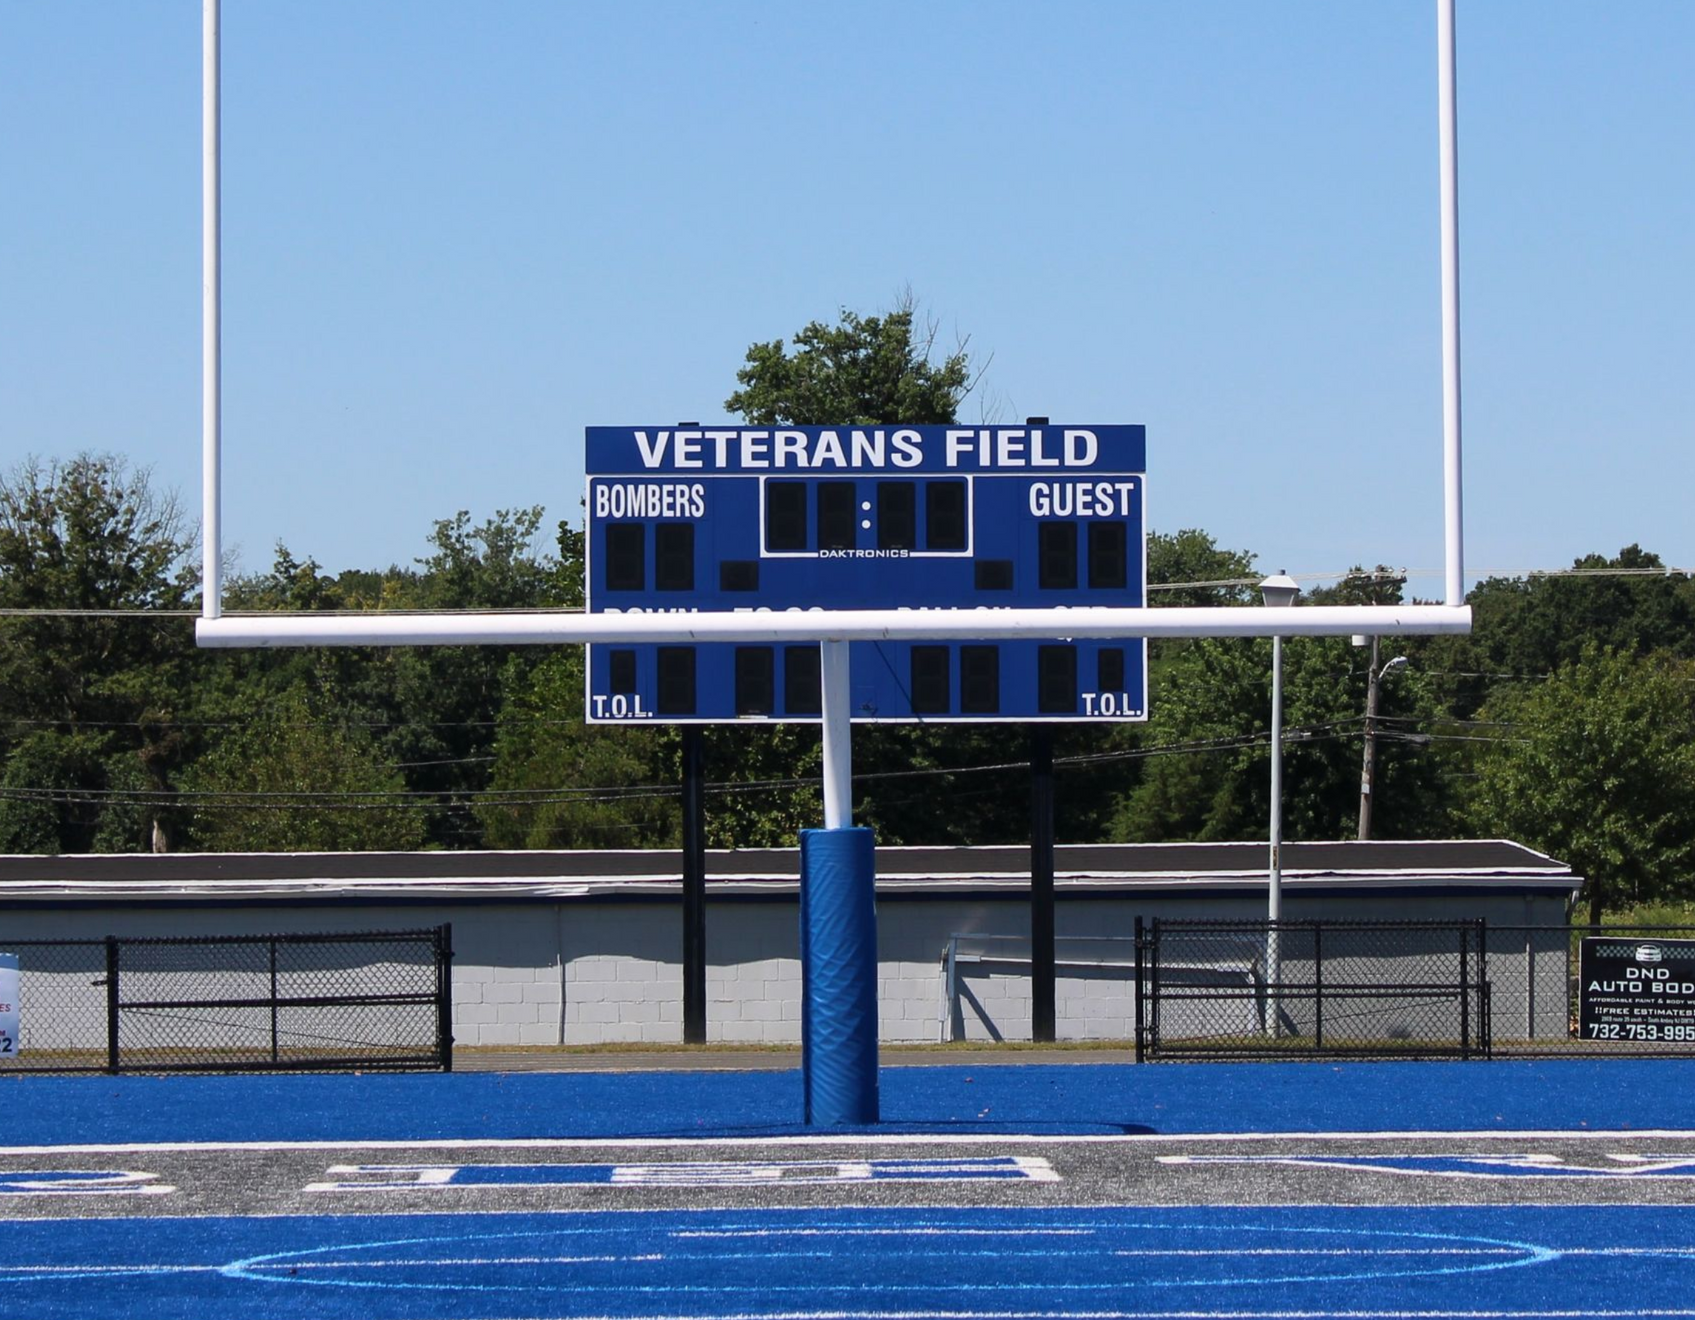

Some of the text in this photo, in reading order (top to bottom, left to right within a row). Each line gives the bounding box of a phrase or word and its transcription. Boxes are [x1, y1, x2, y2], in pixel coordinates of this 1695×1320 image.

[634, 429, 1098, 468] VETERANS FIELD
[596, 484, 705, 518] BOMBERS
[1029, 482, 1134, 516] GUEST
[820, 549, 909, 558] DAKTRONICS
[592, 694, 653, 718] T.O.L.
[1081, 693, 1141, 716] T.O.L.
[1626, 968, 1669, 979] DND
[1588, 980, 1642, 993] AUTO
[1595, 1006, 1630, 1015] !!FREE
